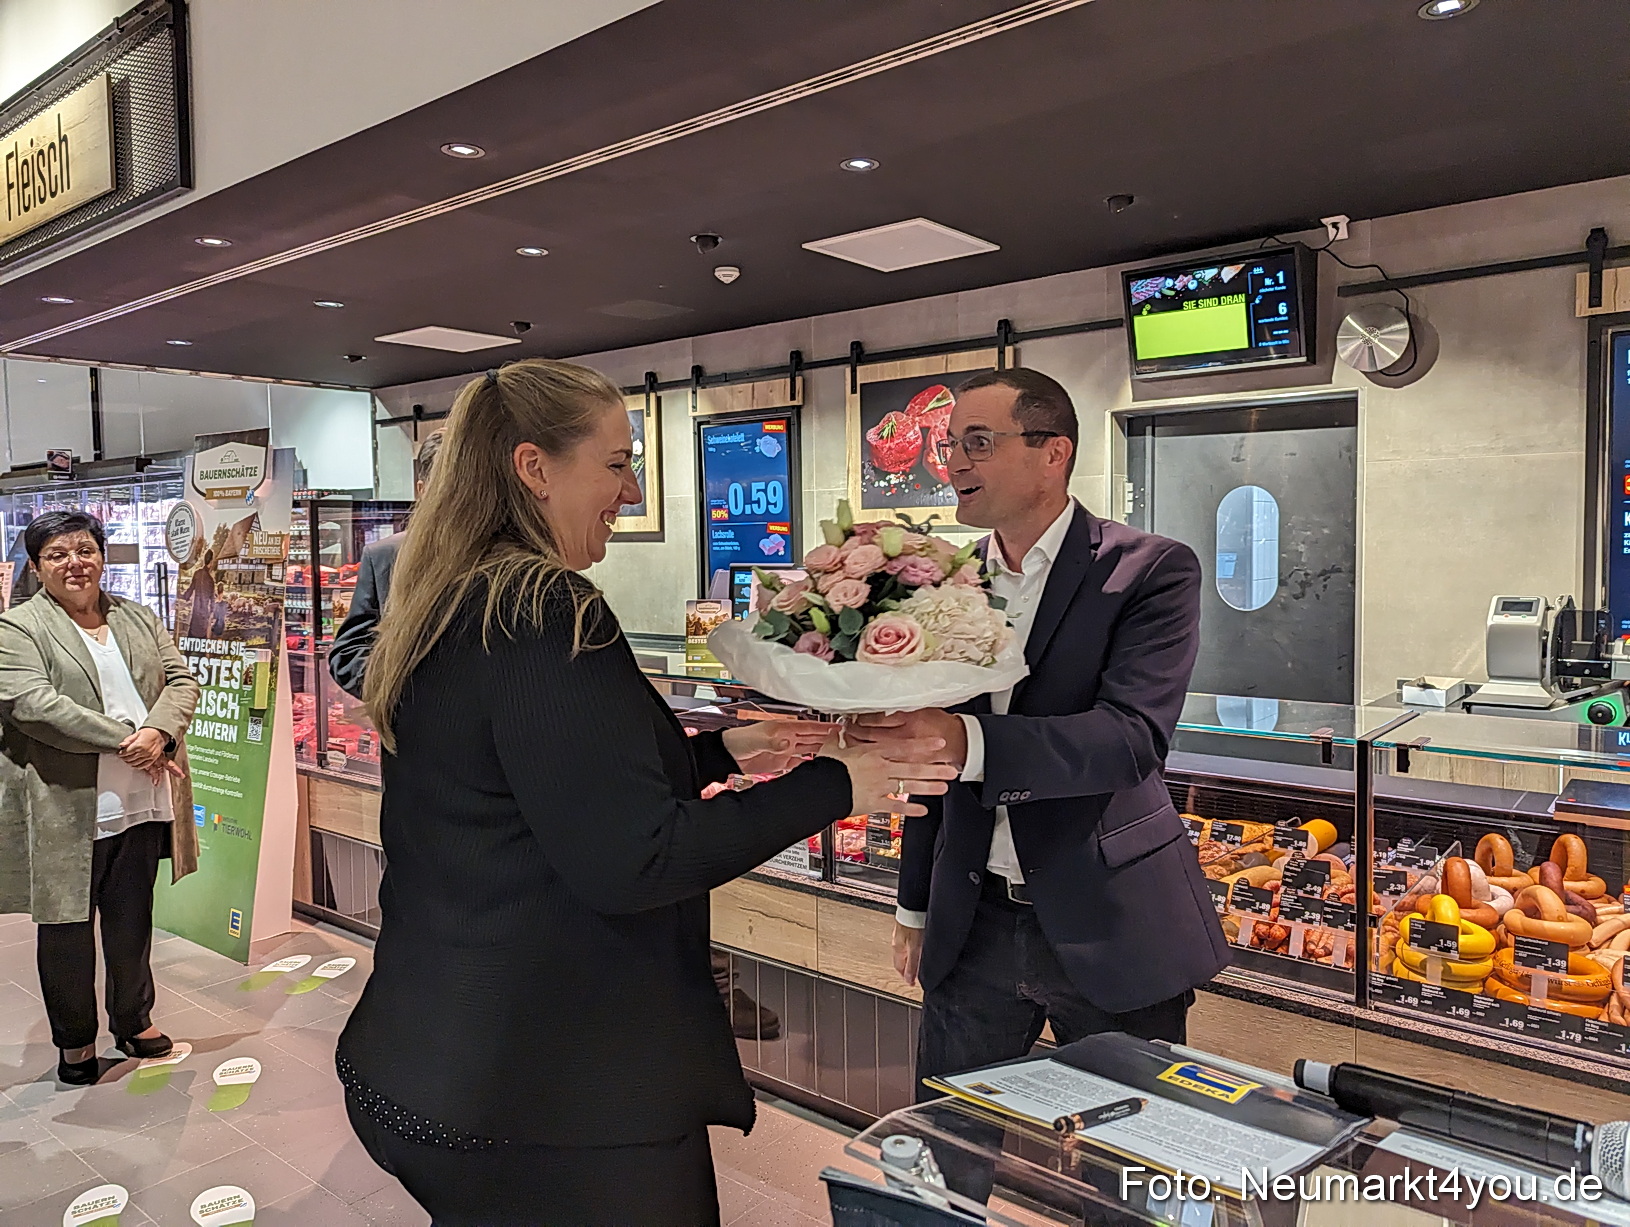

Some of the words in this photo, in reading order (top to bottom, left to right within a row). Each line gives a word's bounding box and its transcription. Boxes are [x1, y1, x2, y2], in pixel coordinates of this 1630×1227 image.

[5, 113, 71, 222] Fleisch
[1264, 277, 1275, 286] Nr.
[1276, 270, 1284, 284] 1
[1182, 299, 1197, 311] SIE
[1198, 296, 1219, 309] SIND
[1220, 293, 1246, 306] DRAN
[1278, 302, 1288, 315] 6
[200, 465, 258, 480] BAUERNSCHÄTZE
[728, 480, 784, 516] 0.59
[711, 509, 729, 519] 50%
[253, 531, 268, 545] NEU
[711, 530, 735, 539] Lachsrolle
[179, 637, 229, 655] ENTDECKEN
[230, 641, 246, 657] SIE
[195, 719, 238, 743] BAYERN
[222, 823, 252, 841] TIERWOHL
[1304, 911, 1321, 921] 2.39
[1438, 938, 1458, 948] 1.59
[1546, 957, 1568, 968] 1.39
[1399, 994, 1419, 1005] 1.69
[1450, 1005, 1471, 1016] 1.69
[1503, 1017, 1525, 1028] 1.69
[1560, 1029, 1582, 1042] 1.79
[218, 1067, 255, 1076] SCHÄTZE
[221, 1064, 254, 1072] BAUERN
[1167, 1075, 1230, 1099] EDEKA
[71, 1198, 118, 1216] SCHÄTZE
[73, 1195, 116, 1210] BAUERN
[198, 1197, 244, 1215] SCHÄTZE
[200, 1194, 241, 1210] BAUERN
